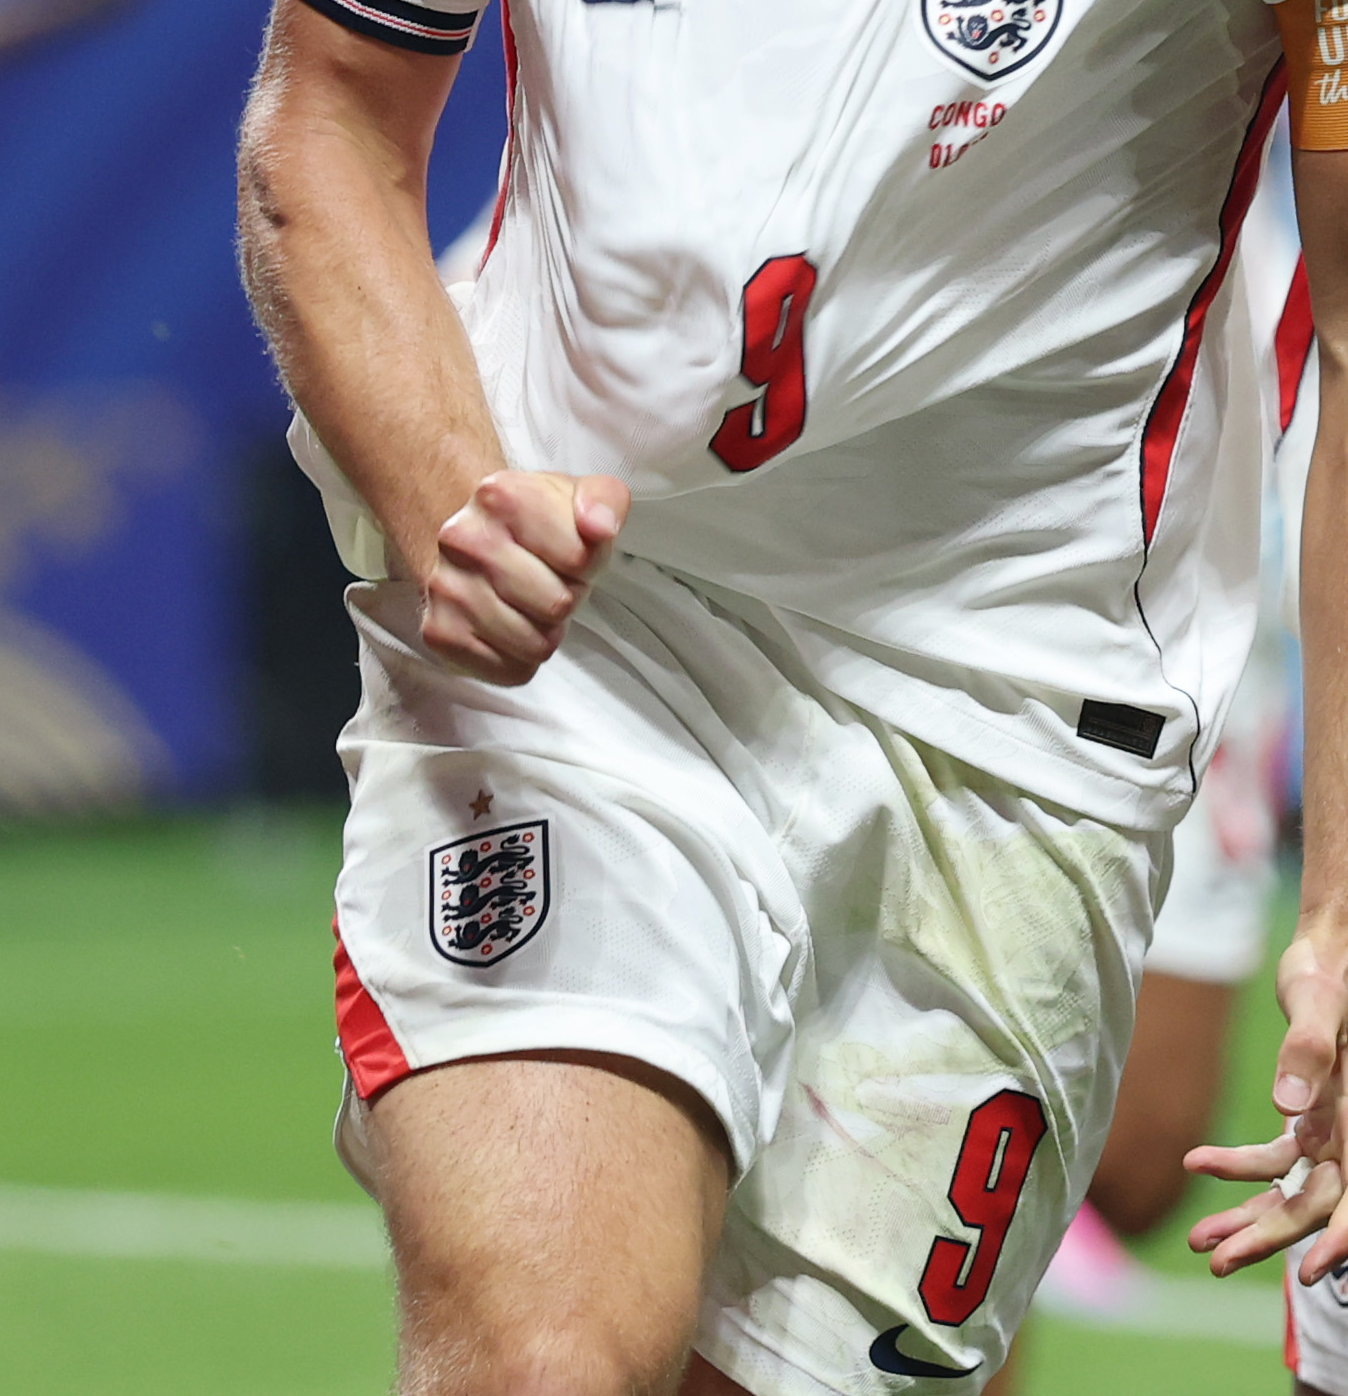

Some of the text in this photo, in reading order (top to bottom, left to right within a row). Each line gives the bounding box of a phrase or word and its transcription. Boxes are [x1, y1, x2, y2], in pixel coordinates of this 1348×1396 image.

[928, 100, 1007, 132] CONGO
[707, 249, 819, 473] 9
[917, 1087, 1049, 1328] 9
